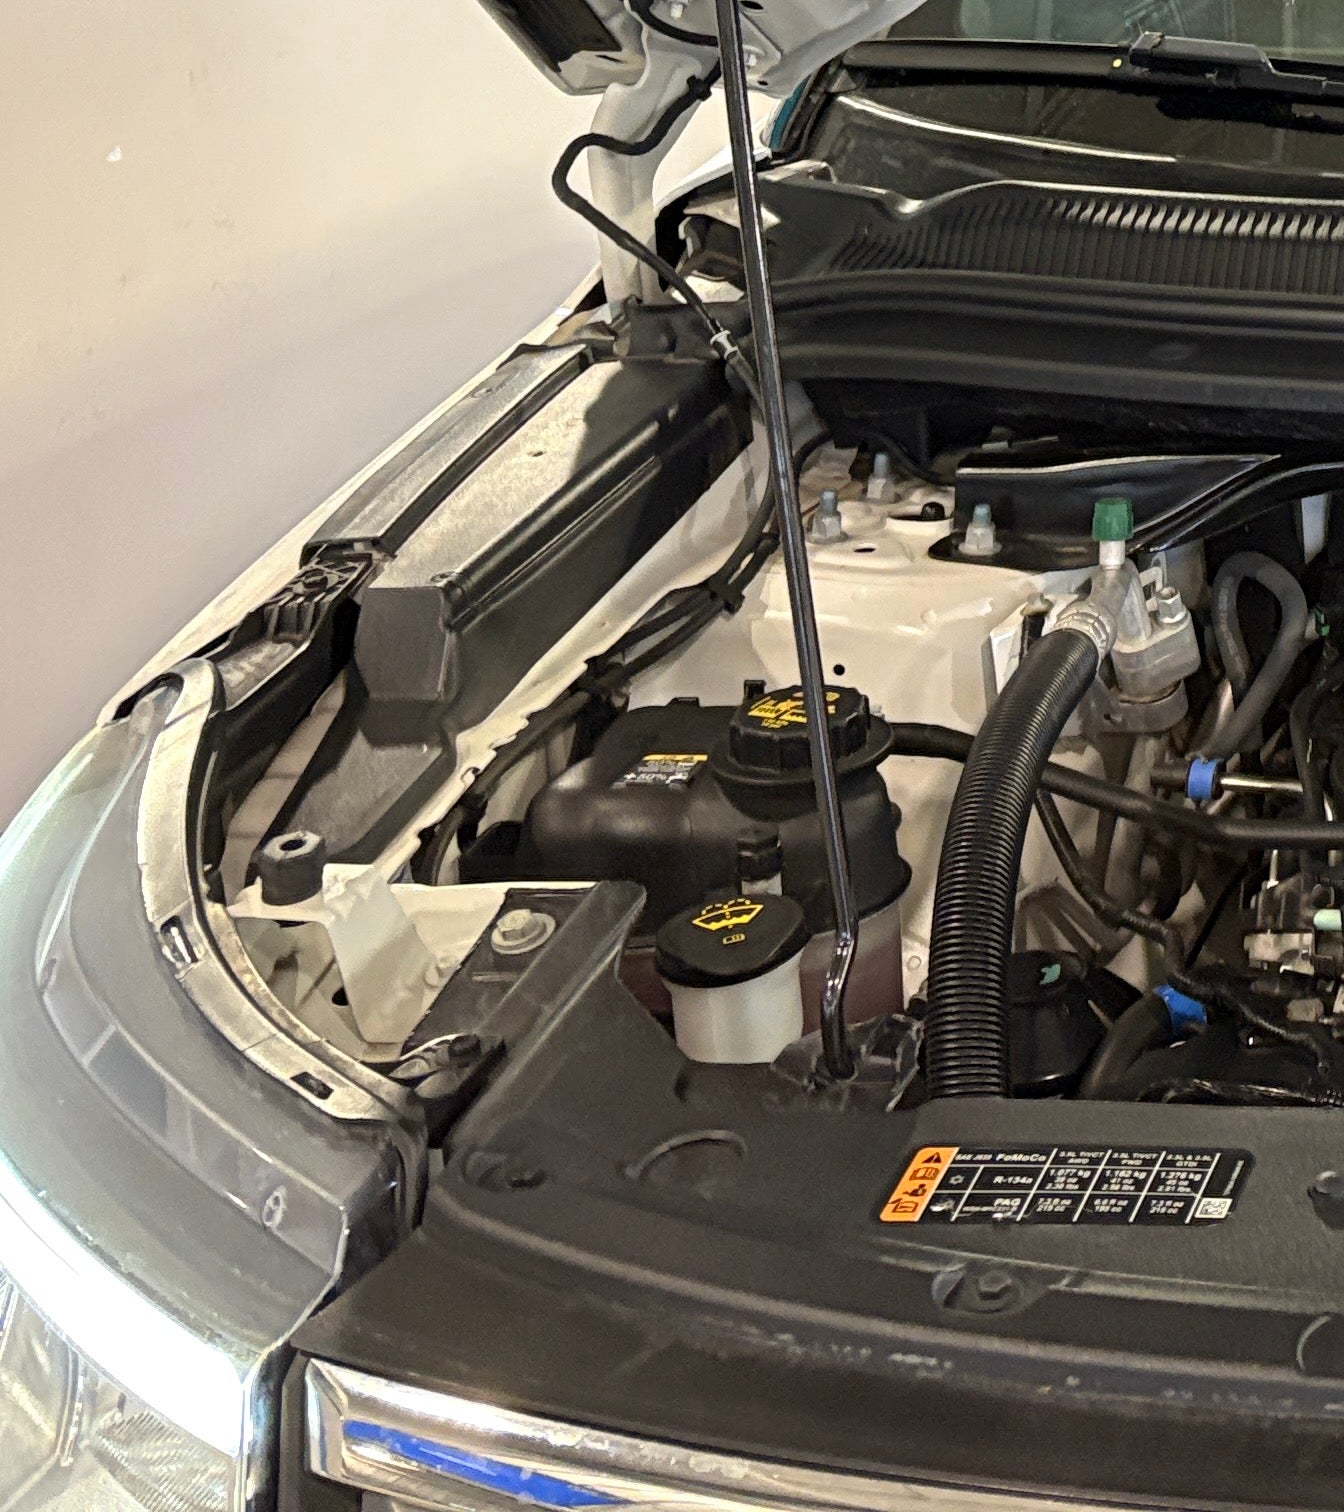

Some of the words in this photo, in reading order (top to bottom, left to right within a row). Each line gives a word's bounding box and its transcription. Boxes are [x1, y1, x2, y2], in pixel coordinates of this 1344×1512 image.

[995, 1153, 1047, 1162] FoMoCo
[993, 1175, 1034, 1184] R-134a
[993, 1197, 1021, 1206] PAG
